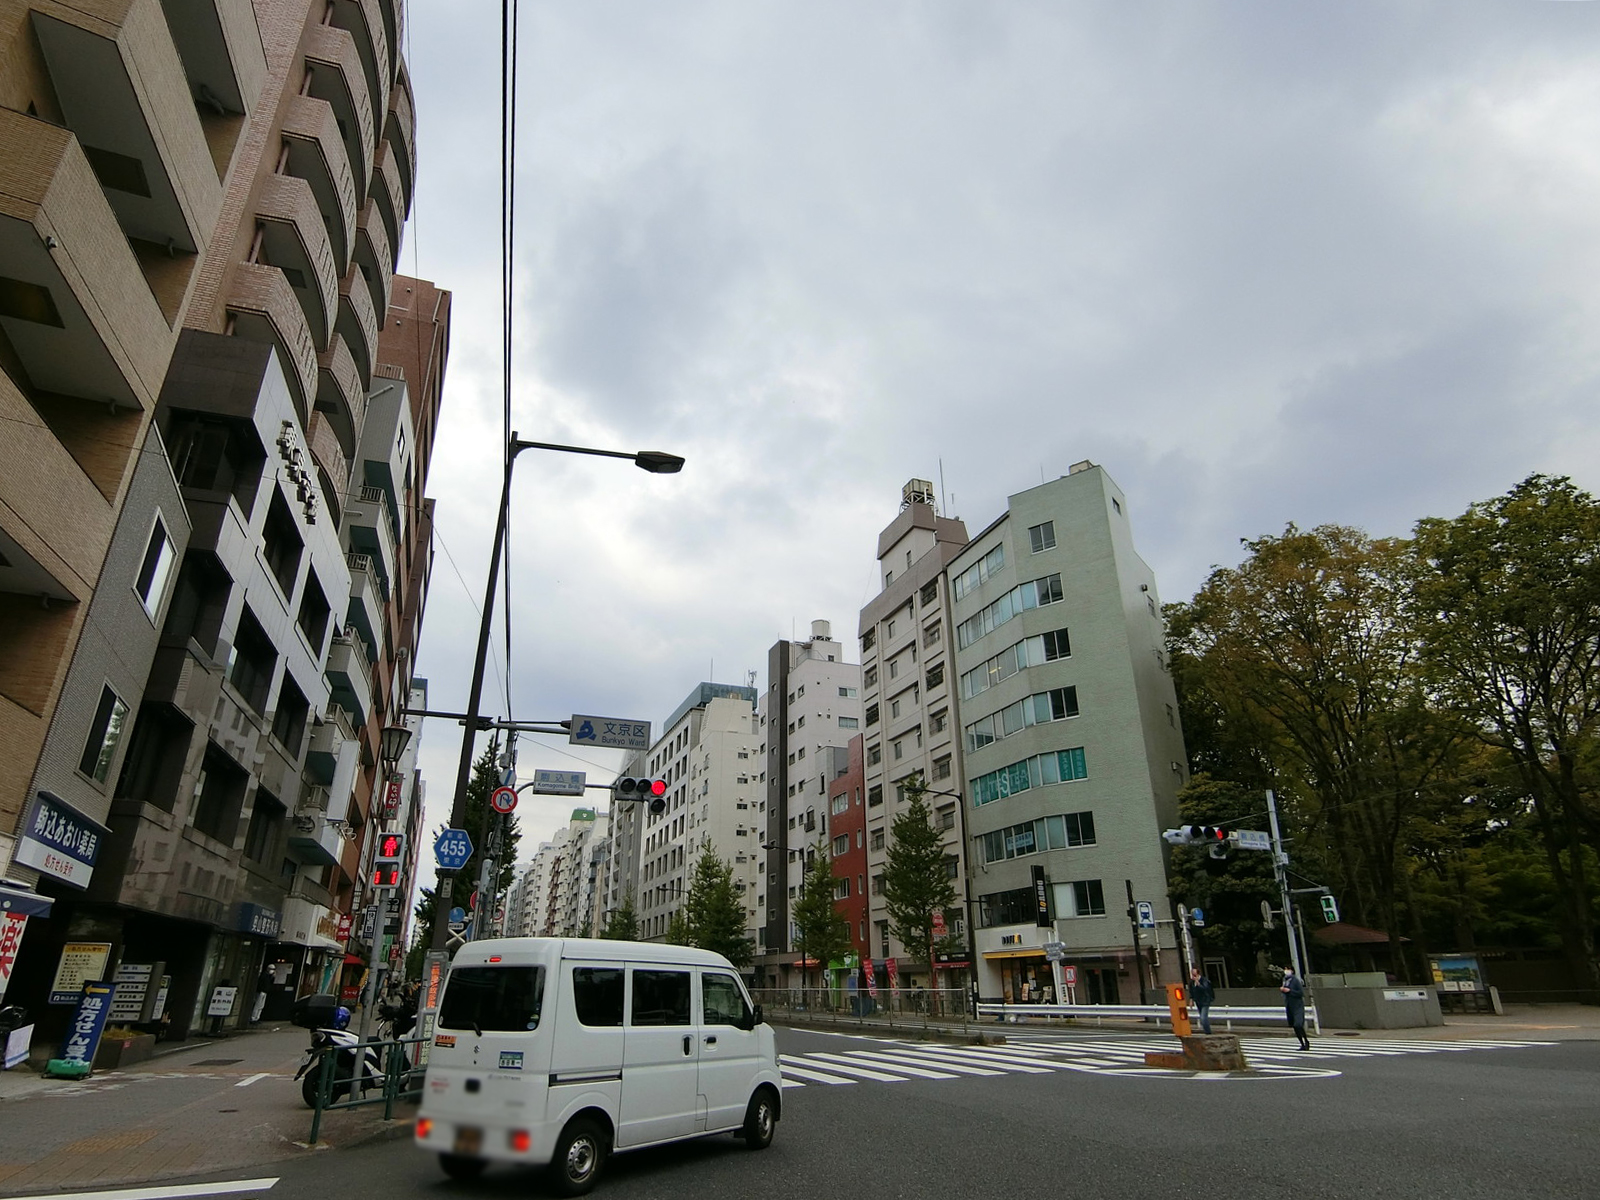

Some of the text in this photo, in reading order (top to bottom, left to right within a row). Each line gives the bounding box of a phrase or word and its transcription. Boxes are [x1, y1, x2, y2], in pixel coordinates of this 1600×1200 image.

[602, 721, 646, 738] 文京区
[601, 735, 646, 747] Bunkyo Ward
[388, 784, 399, 807] なか卯
[33, 804, 97, 861] 駒込あおい薬局
[440, 839, 466, 856] 455
